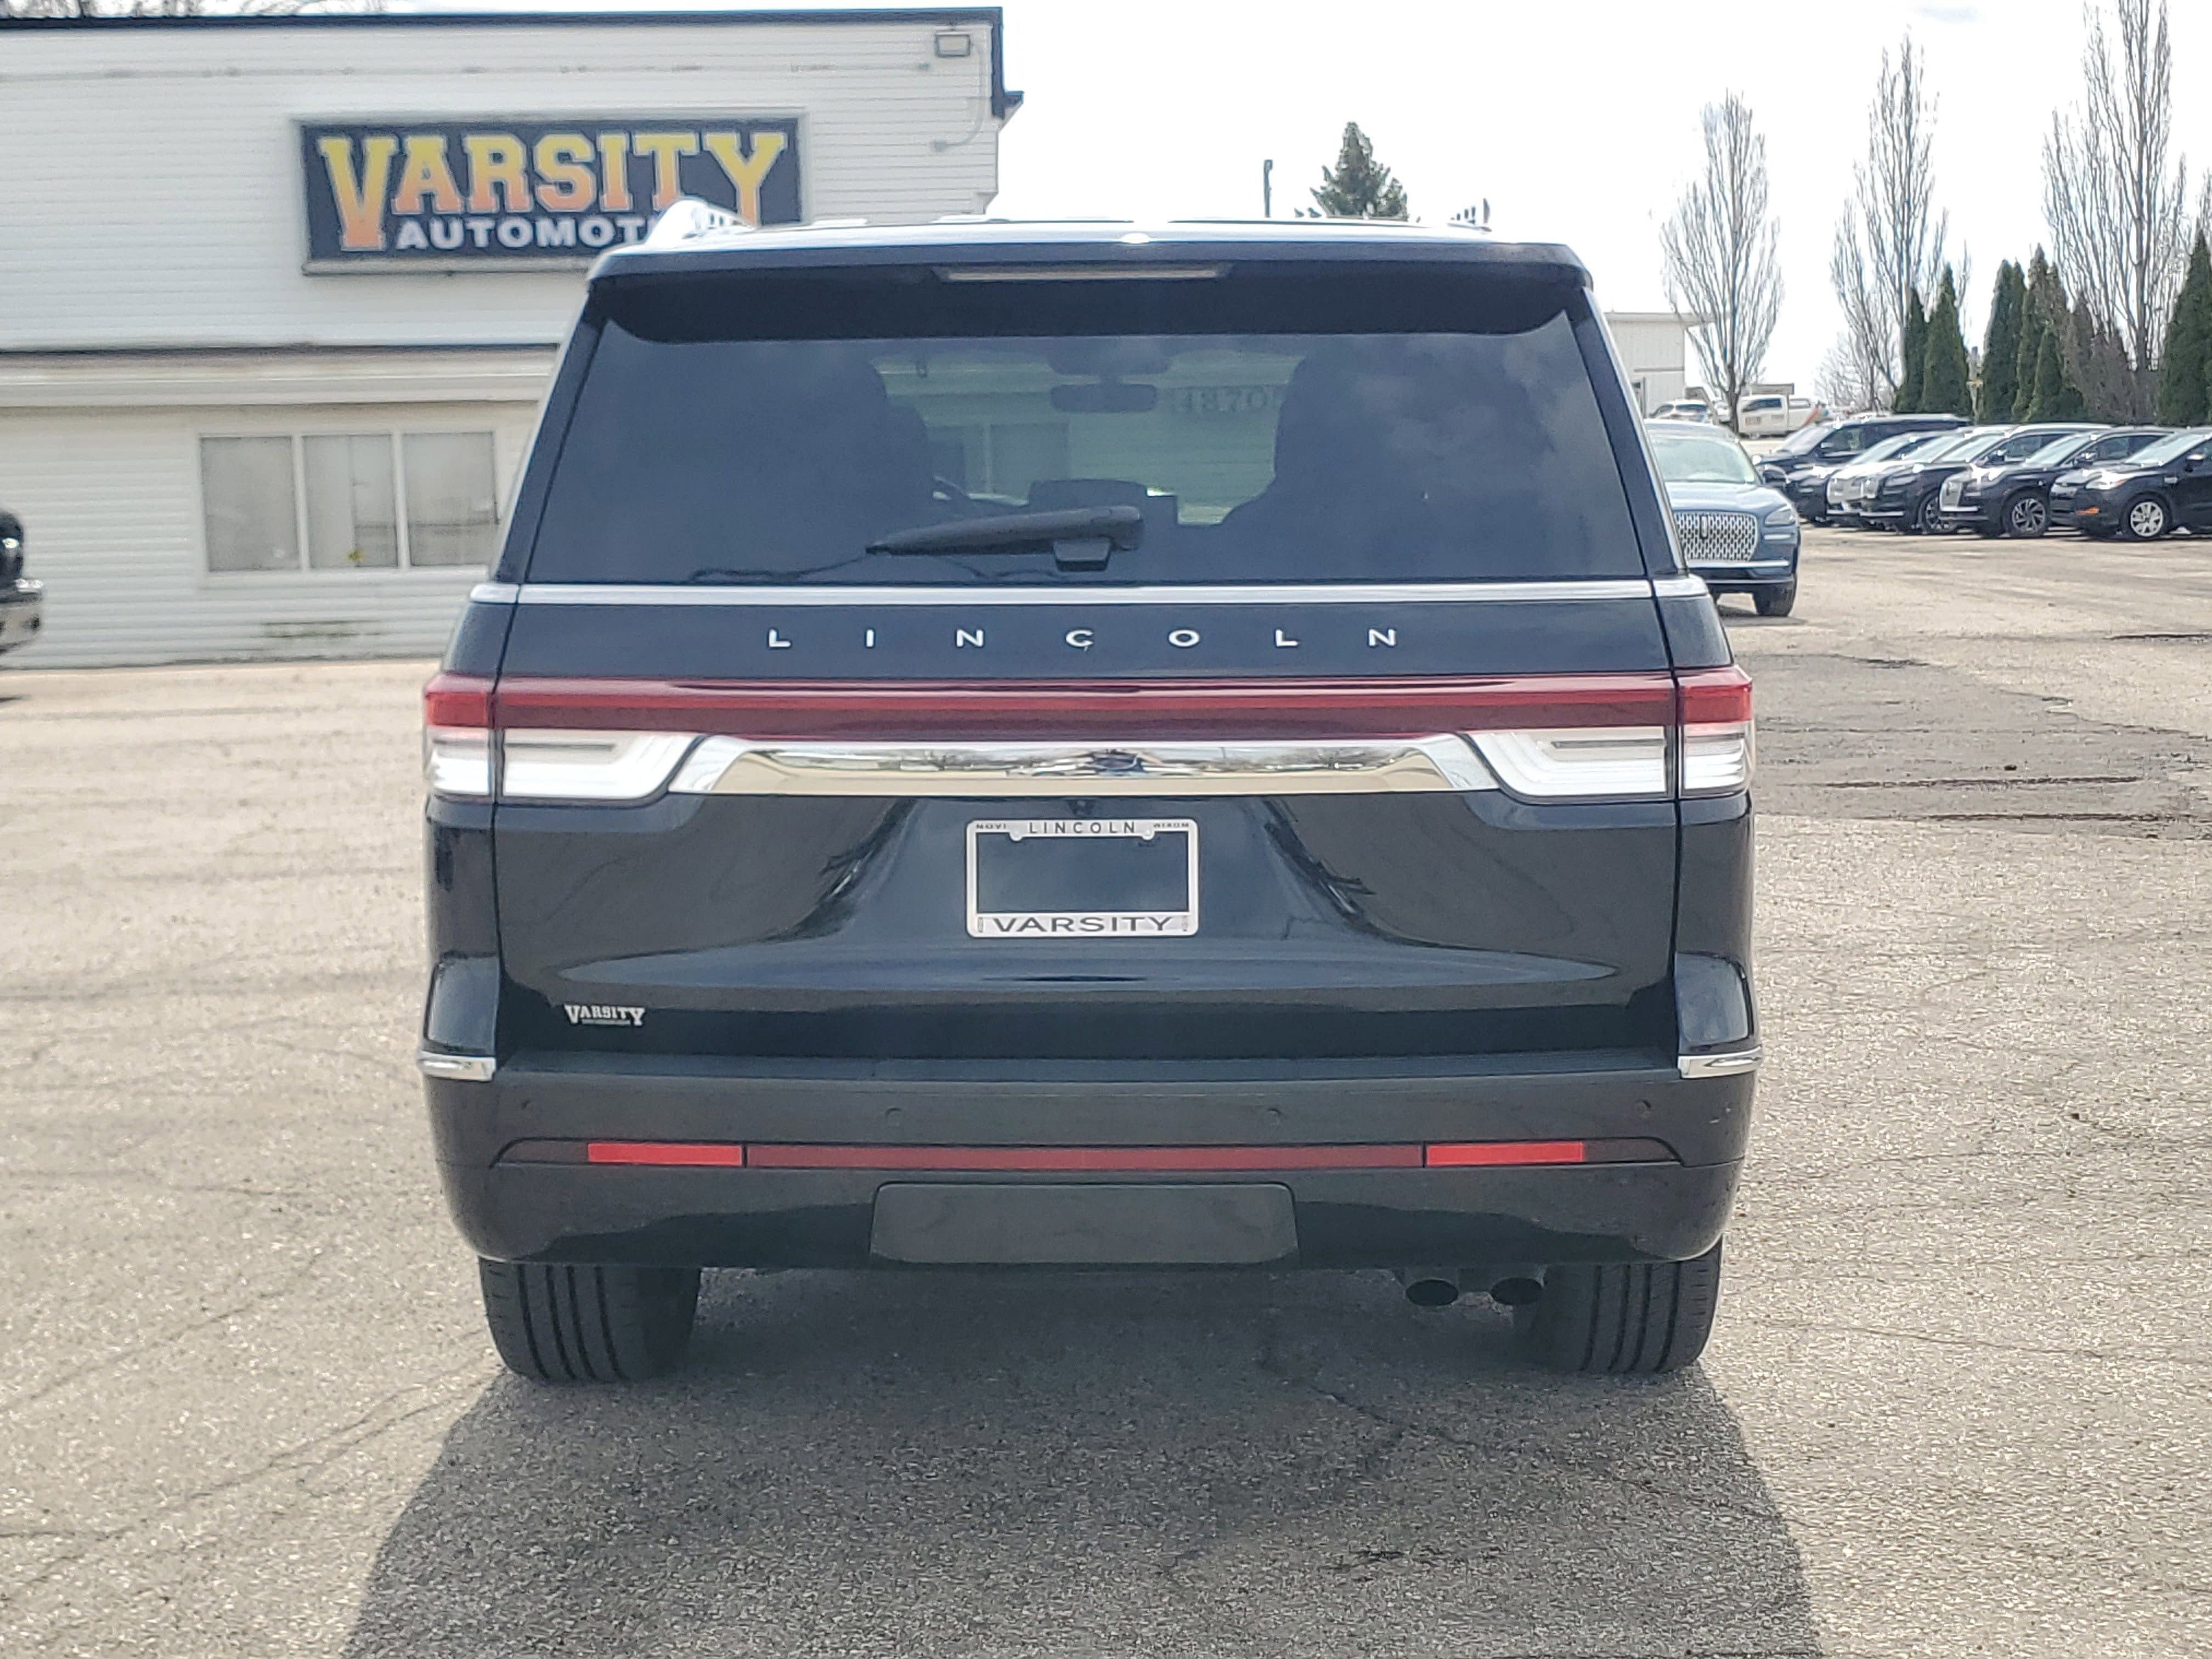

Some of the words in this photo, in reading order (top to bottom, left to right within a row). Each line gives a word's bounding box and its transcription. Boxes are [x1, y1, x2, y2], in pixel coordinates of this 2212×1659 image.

[317, 132, 787, 251] VARSITY
[396, 216, 660, 249] AUTOMOT
[768, 628, 1397, 648] LINCOLN
[1029, 822, 1135, 834] LINCOLN
[994, 917, 1172, 932] VARSITY
[564, 1004, 645, 1026] VARSITY
